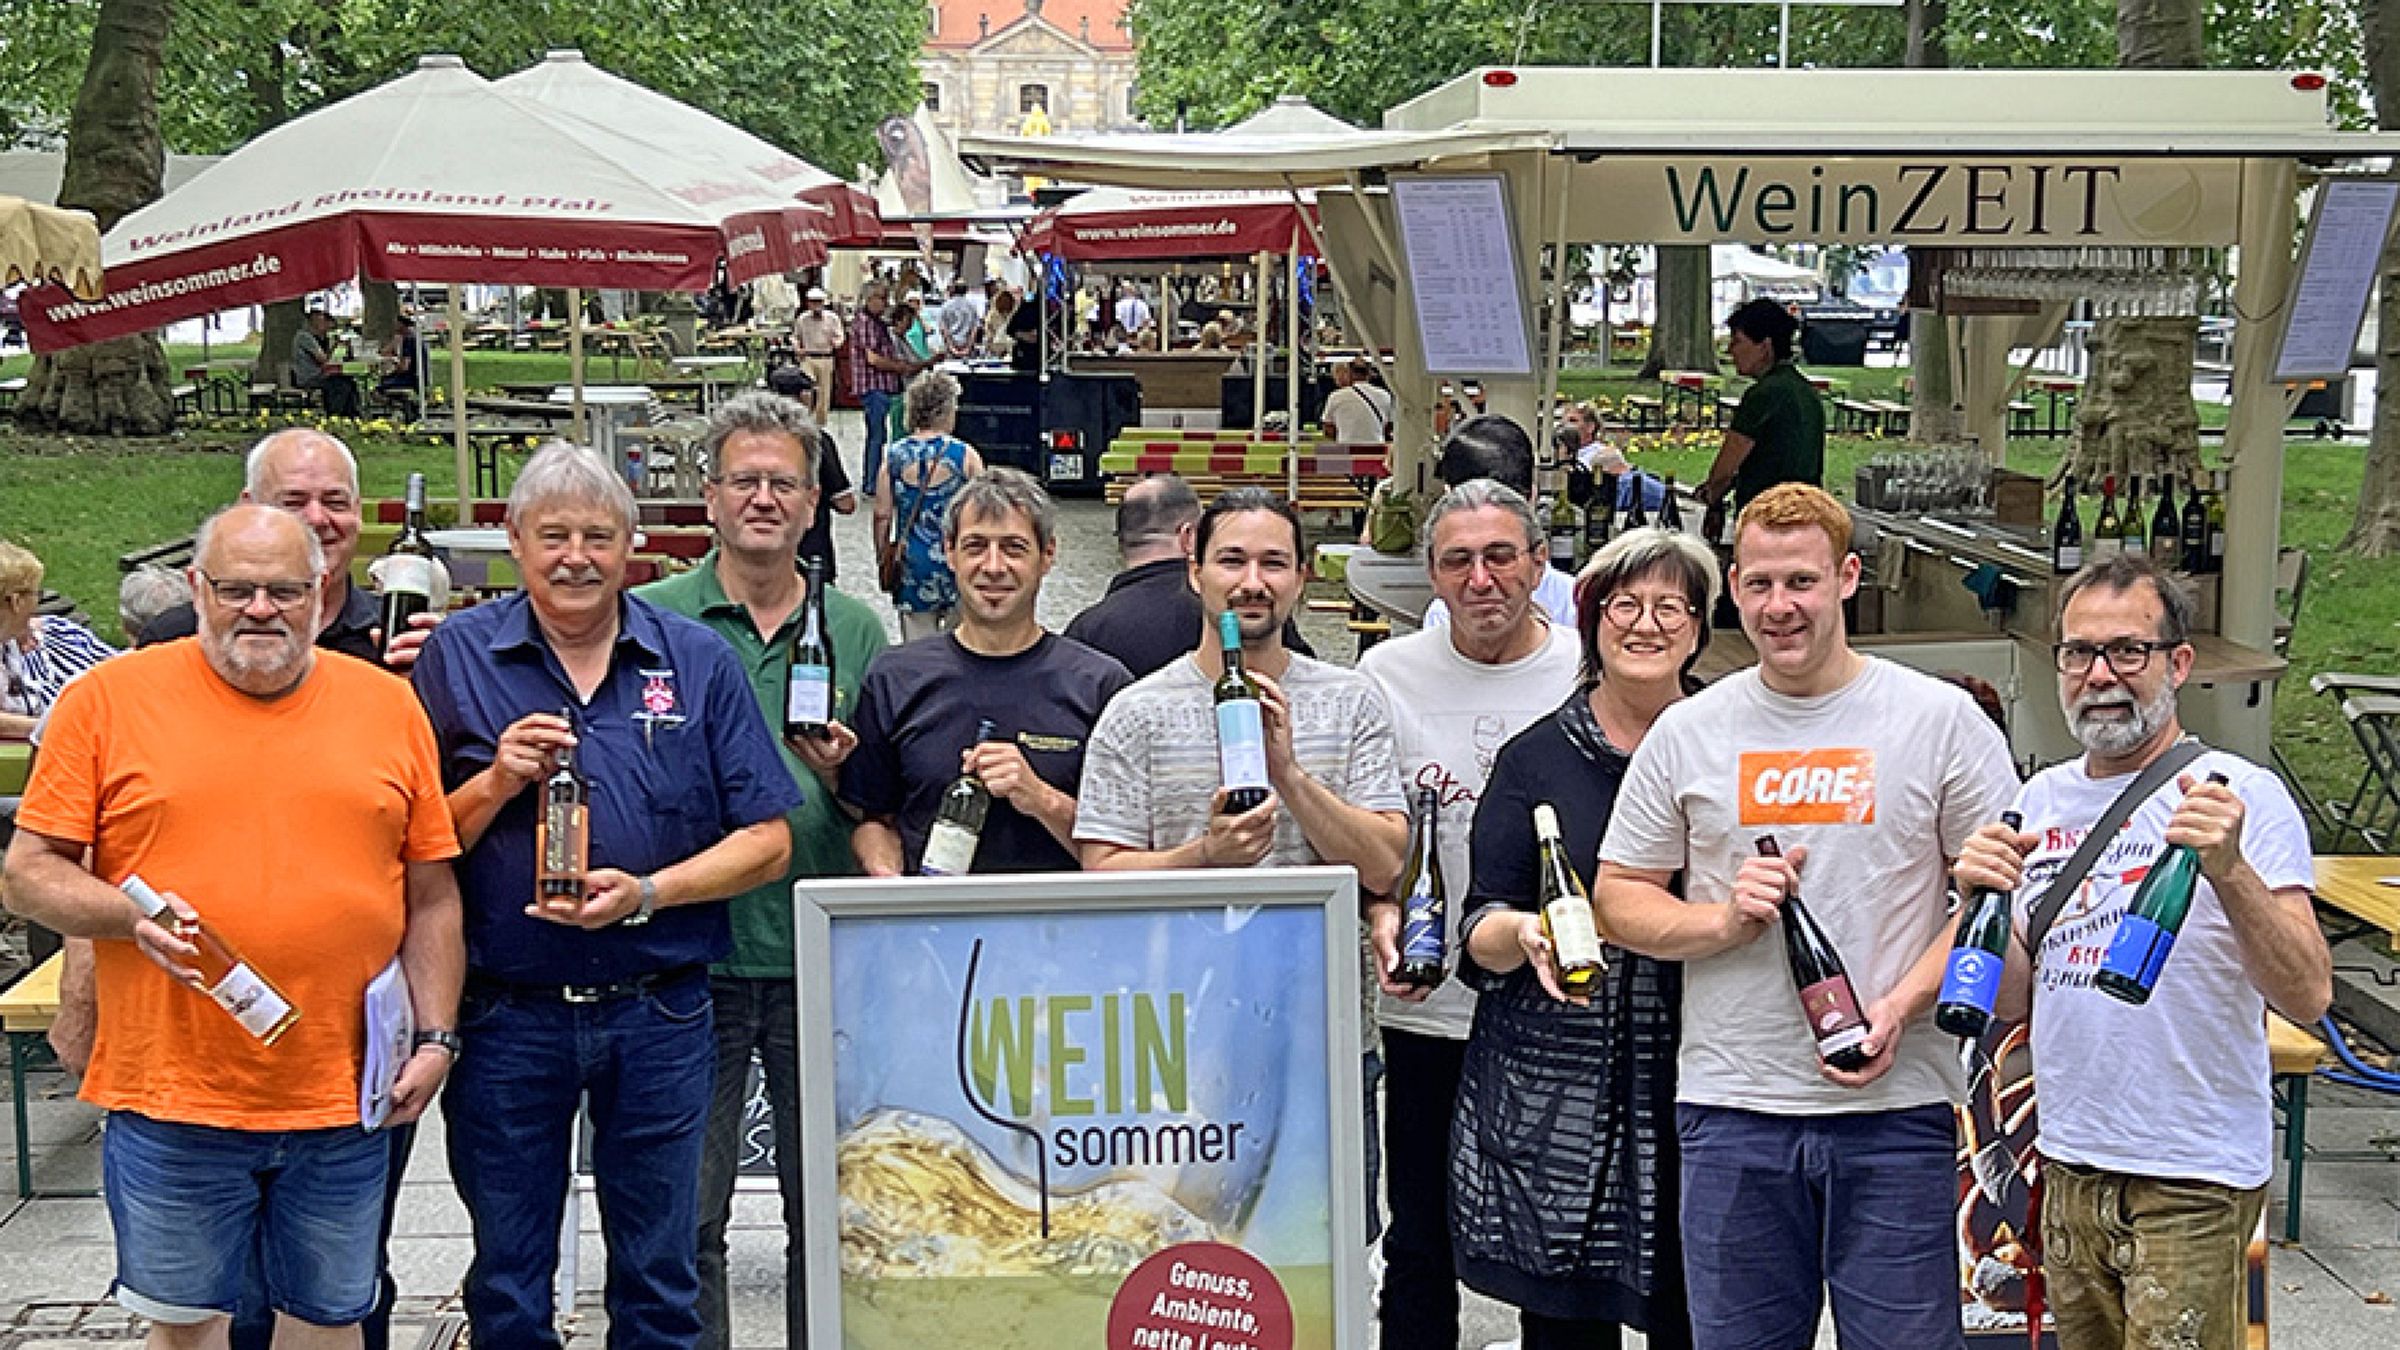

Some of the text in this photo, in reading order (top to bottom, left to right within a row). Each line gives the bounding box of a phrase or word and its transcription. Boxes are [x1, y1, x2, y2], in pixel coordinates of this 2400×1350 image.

[129, 187, 613, 250] Weinland Rheinland-Pfalz
[1664, 165, 2121, 235] WeinZEIT
[1074, 217, 1237, 240] www.weinsommer.de
[45, 252, 281, 322] www.weinsommer.de
[970, 991, 1189, 1117] WEIN
[1055, 1120, 1244, 1167] sommer
[1170, 1261, 1255, 1302] Genuss,
[1150, 1291, 1261, 1337] Ambiente,
